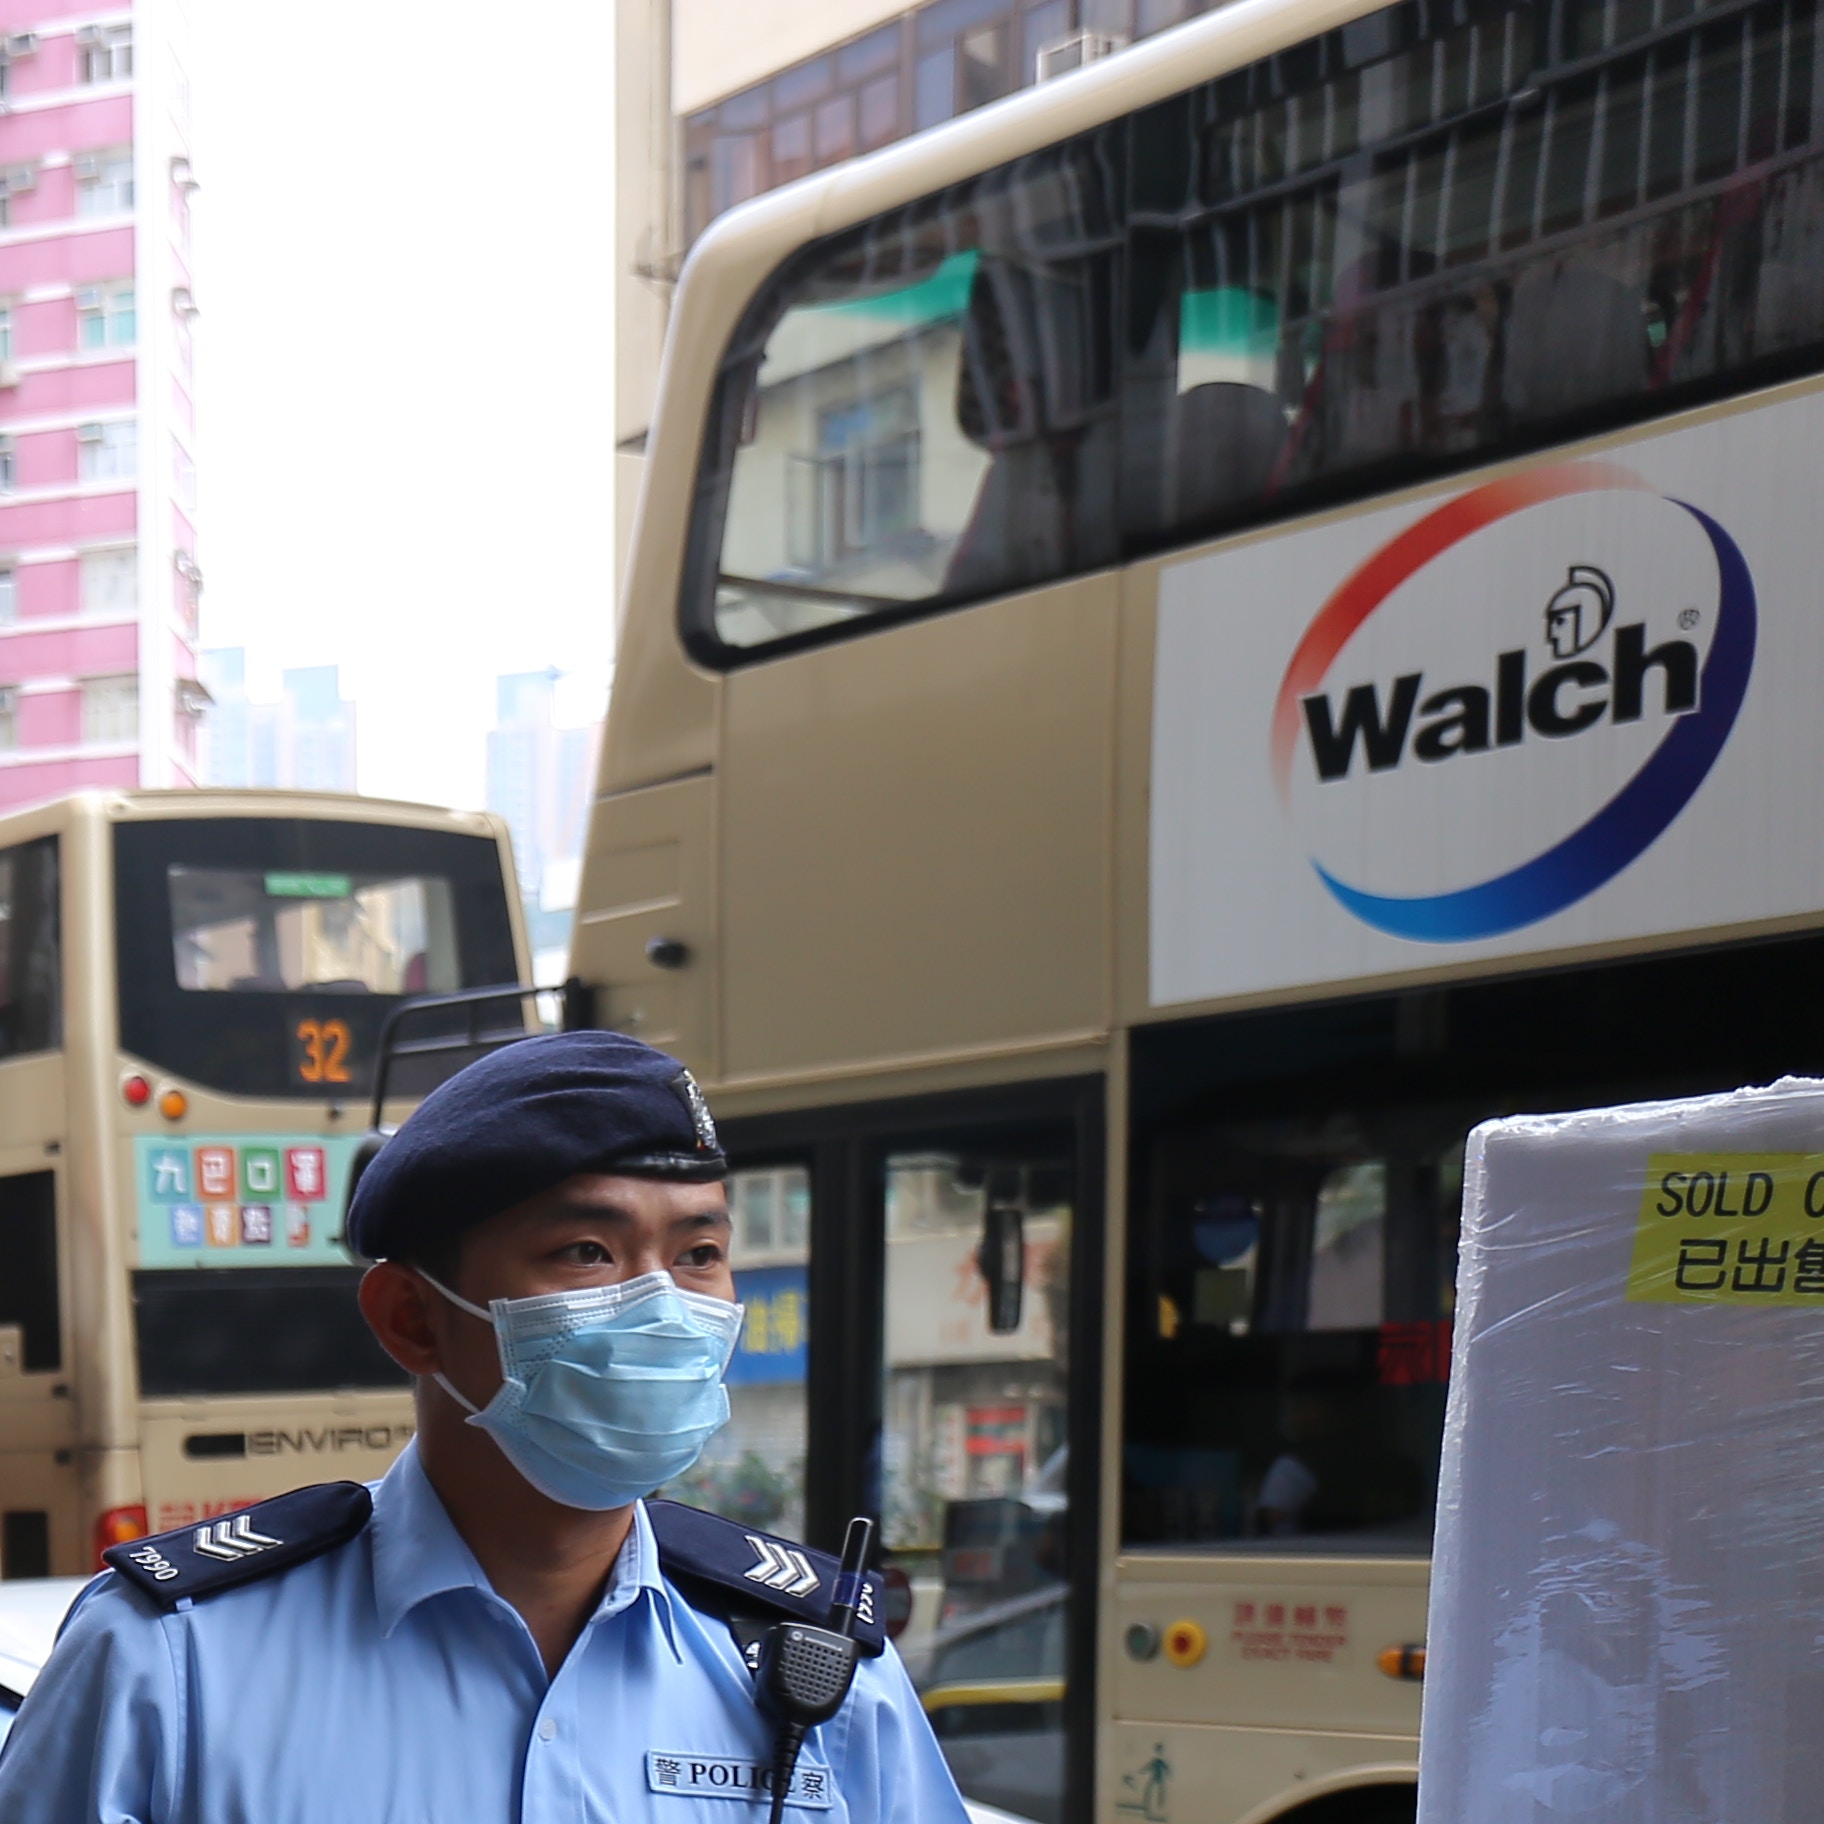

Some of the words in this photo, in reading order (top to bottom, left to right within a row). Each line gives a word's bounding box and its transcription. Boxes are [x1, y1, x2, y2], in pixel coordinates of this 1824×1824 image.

[1299, 622, 1702, 786] Walch
[296, 1019, 354, 1084] 32
[1656, 1170, 1774, 1218] SOLD
[128, 1545, 179, 1581] 7990
[654, 1757, 682, 1787] 警
[689, 1762, 795, 1793] POLIC
[801, 1771, 825, 1800] 察
